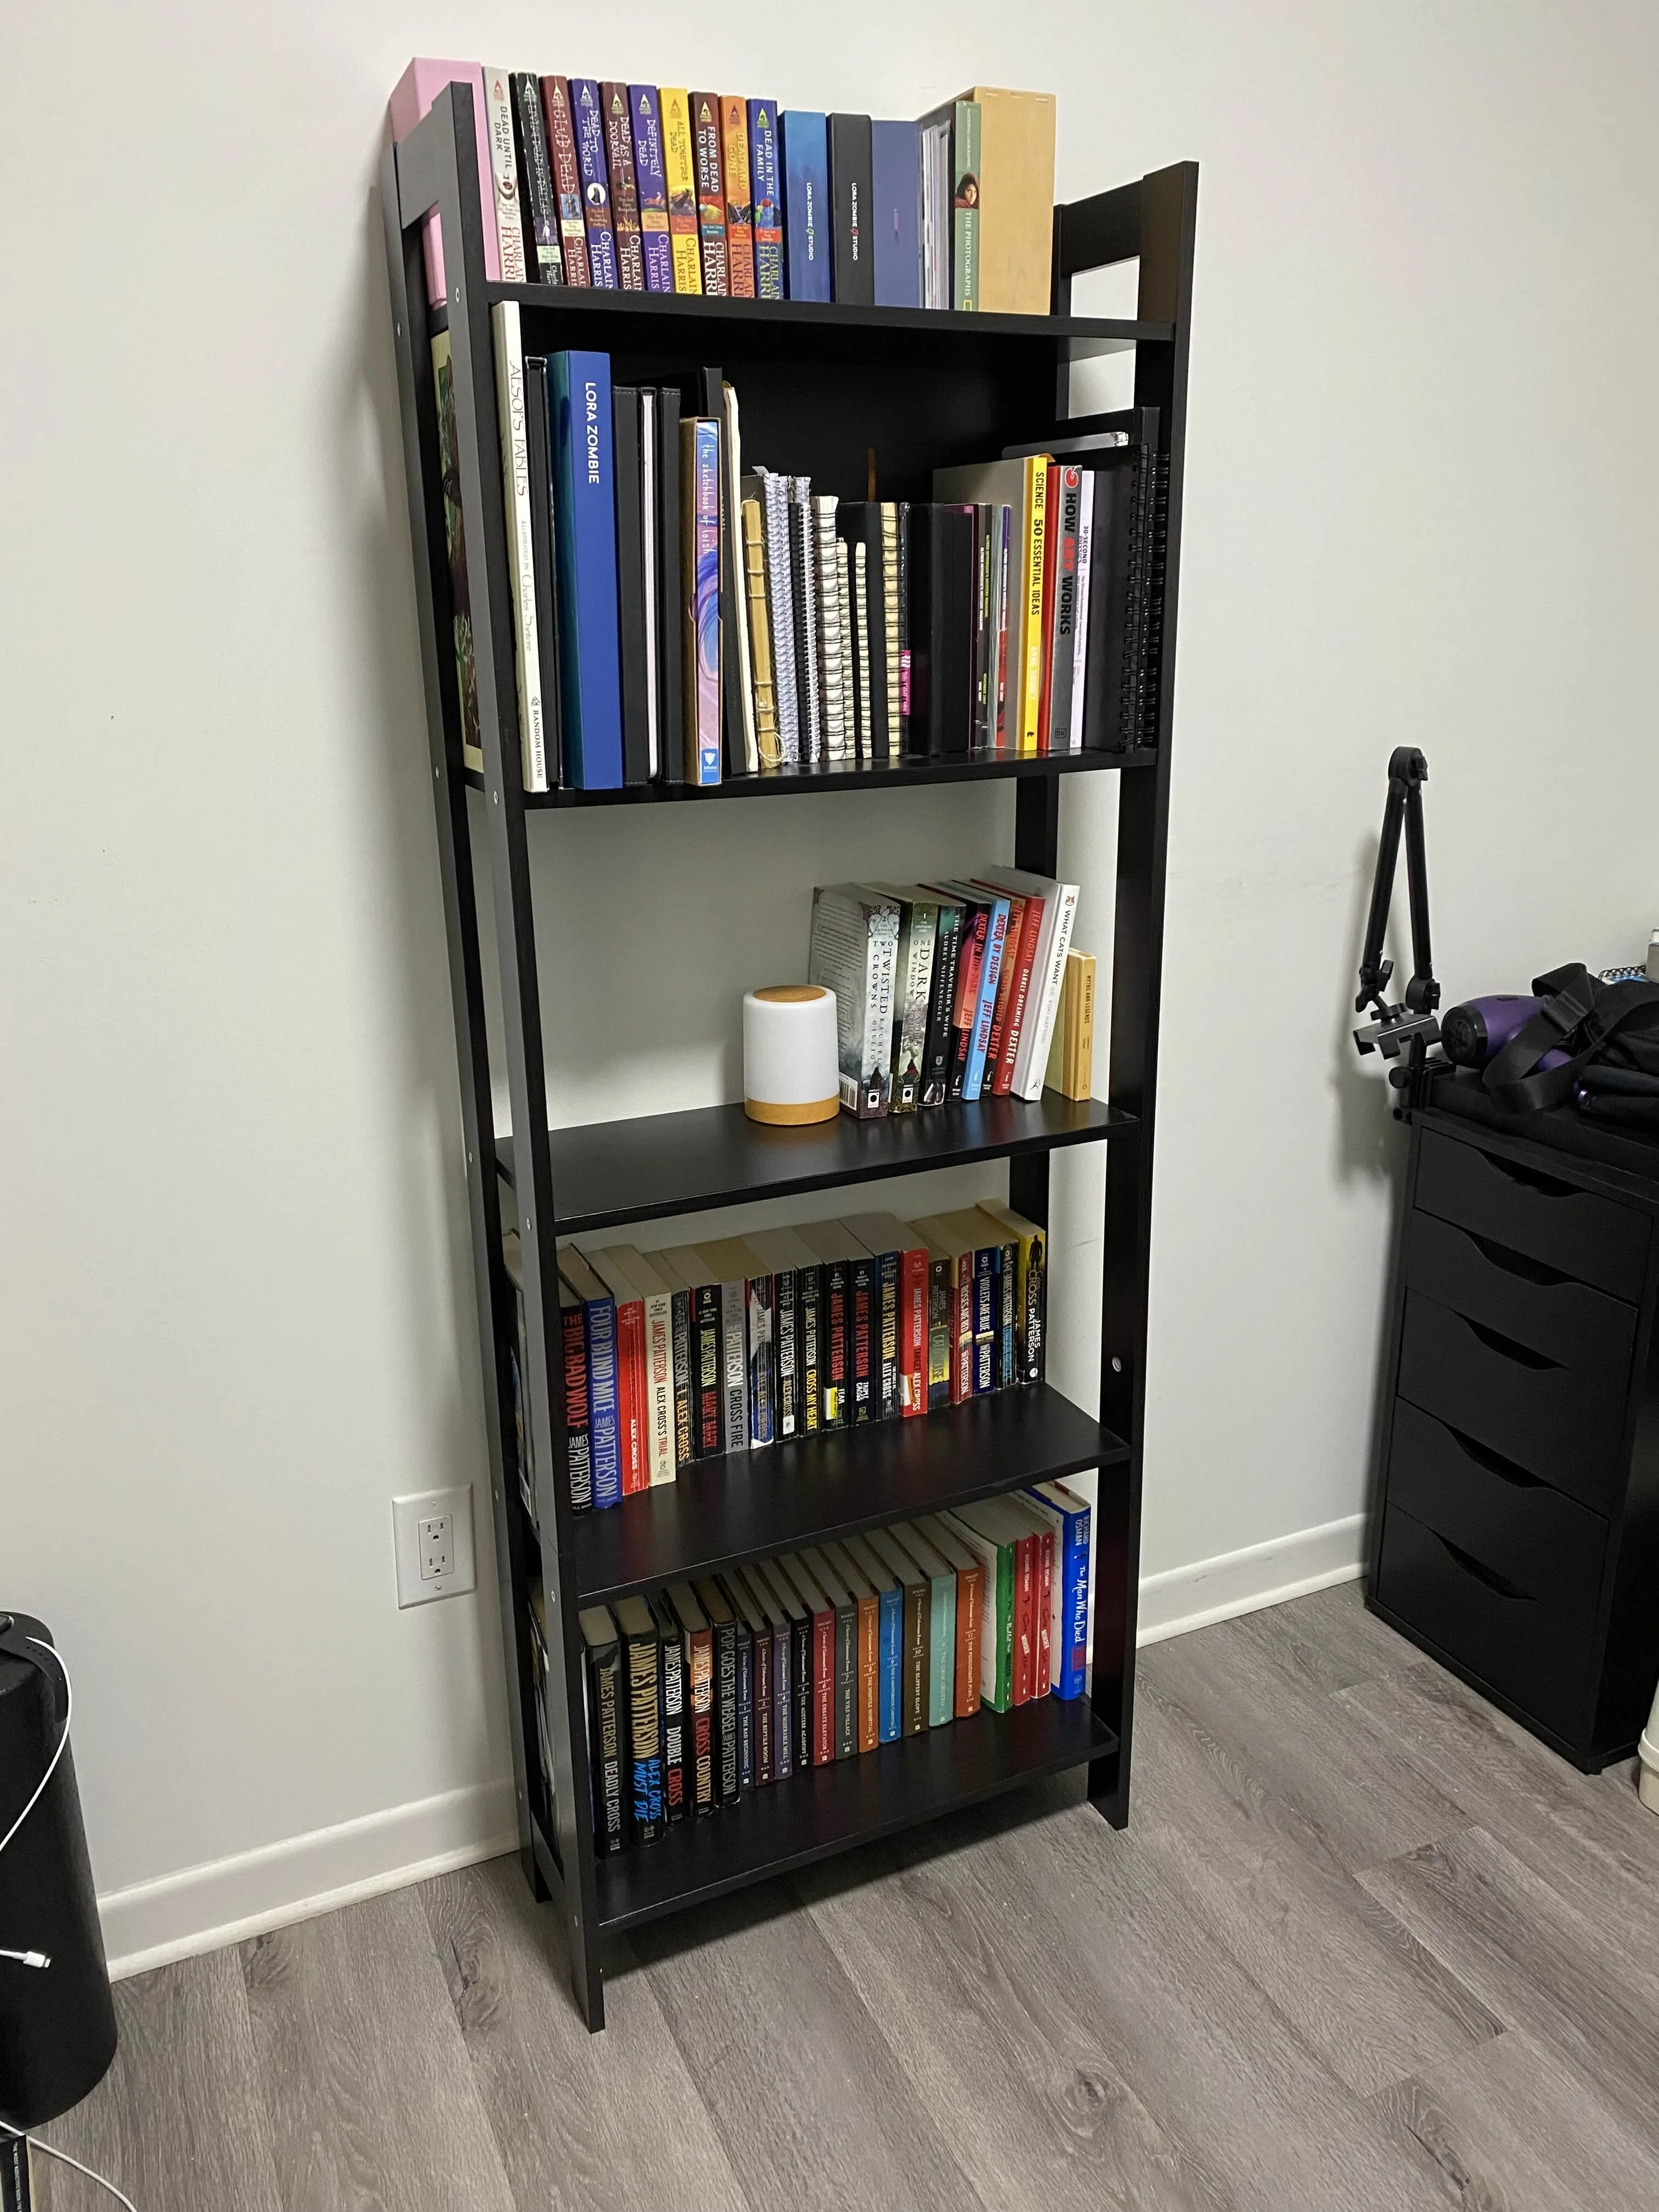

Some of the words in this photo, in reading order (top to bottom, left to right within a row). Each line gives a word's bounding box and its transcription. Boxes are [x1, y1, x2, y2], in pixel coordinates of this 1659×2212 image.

[495, 122, 503, 150] DARK
[500, 106, 510, 134] DEAD
[620, 117, 630, 142] DEAD
[503, 137, 513, 169] UNTIL
[620, 144, 630, 157] AS
[639, 140, 648, 166] DEAD
[670, 131, 679, 153] DEAD
[698, 130, 706, 144] TO
[707, 126, 716, 157] FROM
[737, 133, 746, 162] DEAD
[764, 131, 774, 158] DEAD
[699, 147, 709, 188] WORSE
[728, 145, 737, 176] GONE
[756, 144, 765, 182] FAMILY
[766, 162, 774, 172] IN
[710, 162, 719, 192] DEAD
[738, 166, 747, 189] AND
[766, 176, 775, 196] THE
[501, 226, 517, 281] HARRI
[511, 226, 524, 283] CHARLAIN
[648, 246, 660, 289] HARRIS
[510, 360, 525, 431] AESOP'S
[585, 382, 597, 421] LORA
[514, 439, 528, 496] FABLES
[586, 425, 599, 483] ZOMBIE
[702, 445, 716, 459] the
[702, 464, 715, 511] sketchbook
[1035, 472, 1045, 509] SCIENCE
[699, 515, 716, 526] of
[1034, 519, 1043, 536] 50
[1064, 493, 1076, 533] HOW
[521, 521, 529, 560] ILLUSTRATED
[1062, 537, 1074, 571] ART
[1032, 540, 1042, 586] ESSENTIAL
[522, 574, 534, 611] Charles
[1031, 591, 1041, 615] IDEAS
[1060, 575, 1074, 635] WORKS
[523, 614, 537, 652] Santore
[533, 710, 542, 748] RANDOM
[535, 751, 544, 778] HOUSE
[992, 913, 1006, 941] DEXTER
[1031, 911, 1041, 928] JEFF
[994, 944, 1001, 953] BY
[1024, 930, 1037, 962] LINDSAY
[871, 955, 879, 1008] CROWNS
[879, 948, 892, 1014] TWISTED
[909, 952, 917, 996] WINDOW
[916, 950, 930, 1001] DARK
[945, 961, 956, 1012] TRAVELER'S
[988, 956, 1000, 985] DESIGN
[1020, 969, 1030, 992] DARKLY
[936, 966, 946, 1022] NIFFENEGGER
[982, 1000, 994, 1018] JEFF
[1013, 994, 1024, 1026] DREAMING
[877, 1018, 885, 1063] RACHEL
[977, 1020, 990, 1053] LINDSAY
[1005, 1030, 1019, 1065] DEXTER
[882, 1282, 895, 1310] JAMES
[1028, 1269, 1036, 1305] CROSS
[805, 1307, 815, 1328] JAMES
[831, 1293, 843, 1325] JAMES
[882, 1312, 895, 1360] PATTERSON
[913, 1310, 921, 1346] PATTERSON
[805, 1330, 816, 1365] PATTERSON
[831, 1327, 843, 1380] PATTERSON
[806, 1369, 816, 1393] CROSS
[882, 1362, 891, 1378] ALEX
[979, 1350, 990, 1388] PATTERSON
[807, 1394, 816, 1406] MY
[883, 1378, 891, 1399] CROSS
[807, 1407, 817, 1431] HEART
[568, 1434, 589, 1449] JAMES
[568, 1448, 591, 1504] PATTERSON
[1072, 1579, 1087, 1600] Man
[1075, 1600, 1087, 1620] Who
[1074, 1621, 1085, 1644] Died
[665, 1645, 681, 1671] JAMES
[693, 1645, 710, 1671] JAMES
[665, 1671, 682, 1716] PATTERSON
[695, 1669, 711, 1713] PATTERSON
[666, 1726, 682, 1765] DOUBLE
[695, 1717, 710, 1756] CROSS
[668, 1768, 683, 1807] CROSS
[696, 1755, 711, 1803] COUNTRY
